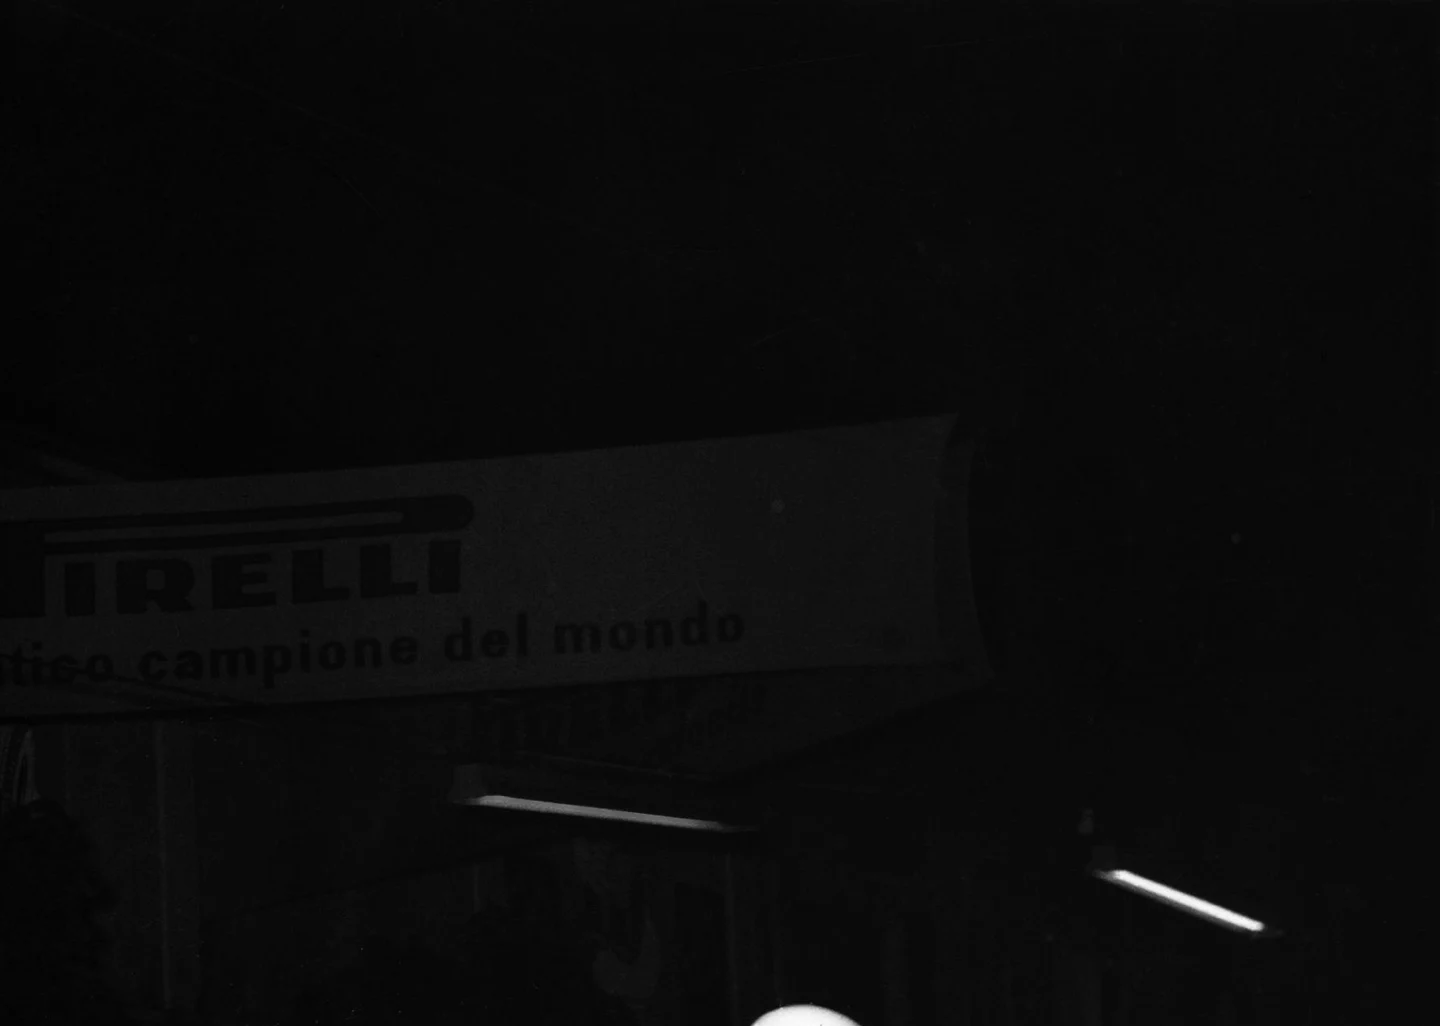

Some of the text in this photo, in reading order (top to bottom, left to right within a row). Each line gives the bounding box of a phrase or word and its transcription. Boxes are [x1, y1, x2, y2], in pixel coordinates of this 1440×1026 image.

[137, 628, 420, 690] campione
[443, 611, 530, 663] del
[552, 599, 746, 655] mondo
